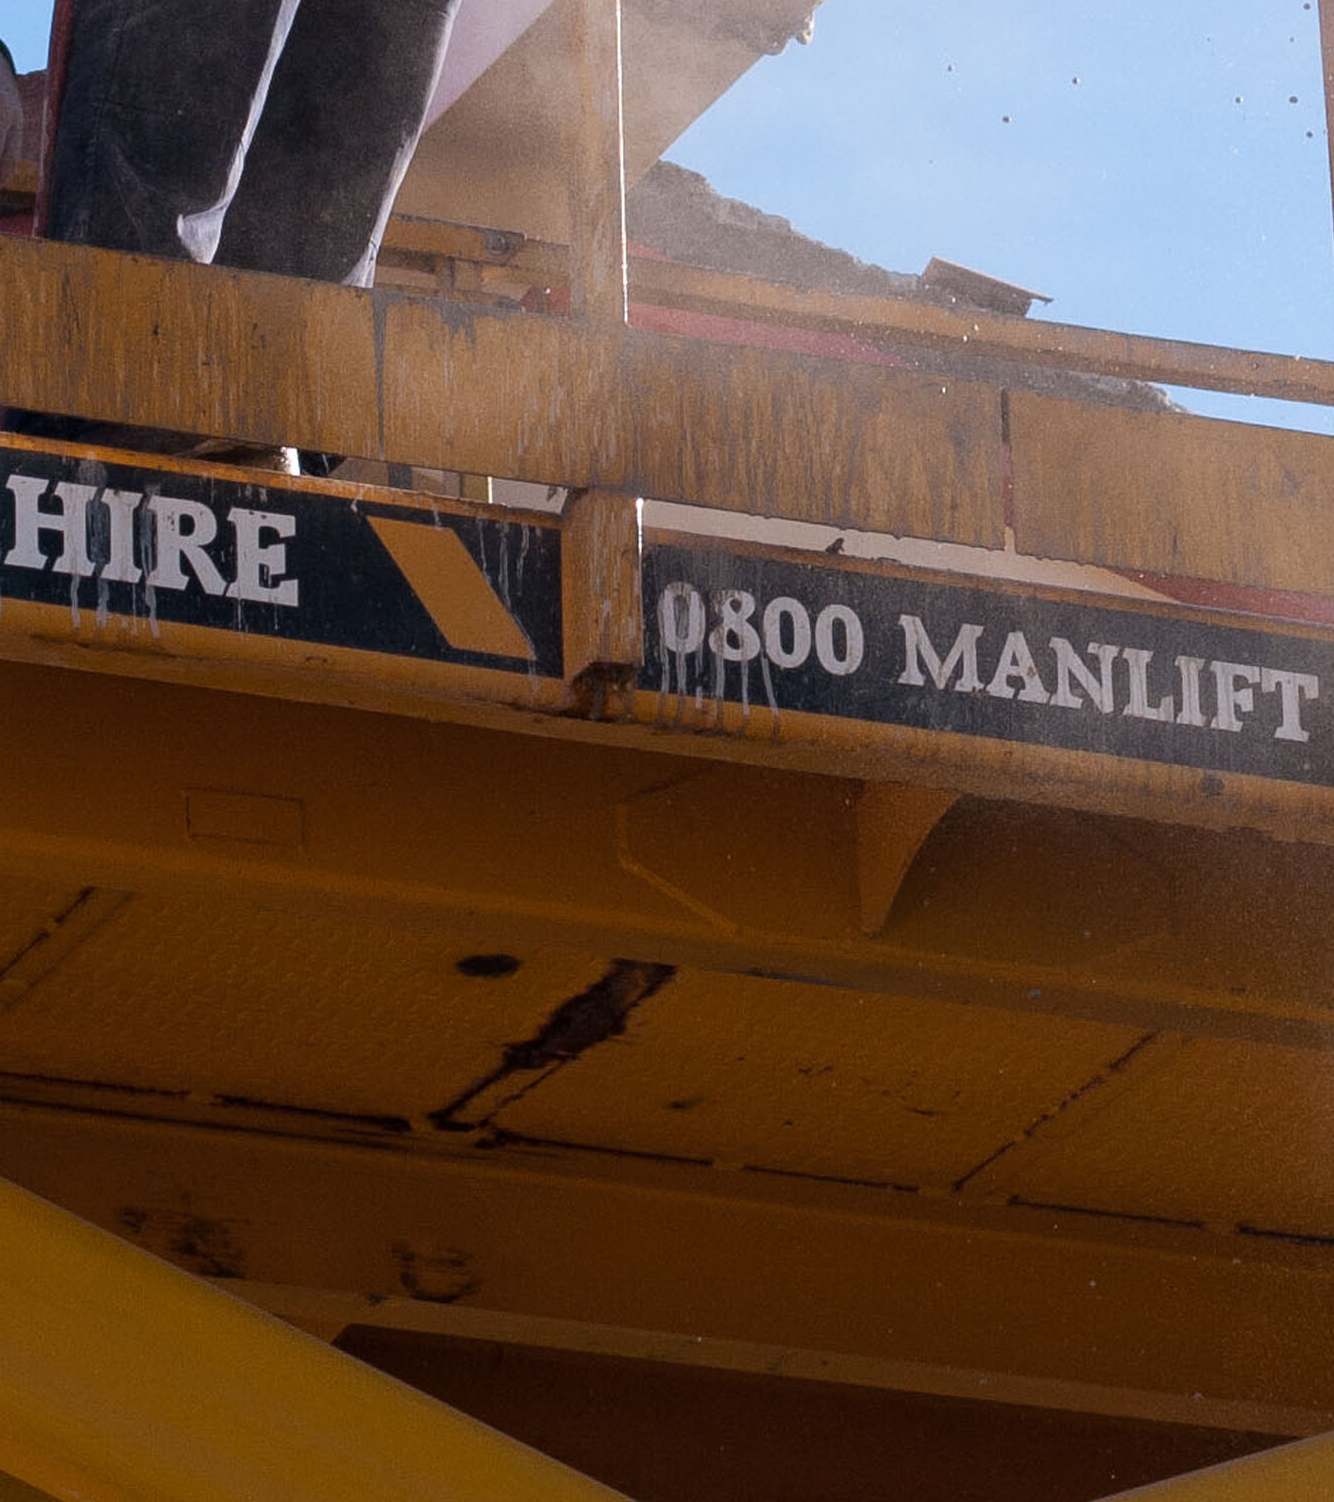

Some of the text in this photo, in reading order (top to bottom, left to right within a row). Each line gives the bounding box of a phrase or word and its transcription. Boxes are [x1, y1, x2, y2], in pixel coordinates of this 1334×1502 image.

[4, 474, 299, 607] HIRE
[657, 581, 1320, 743] 0800 MANLIFT
